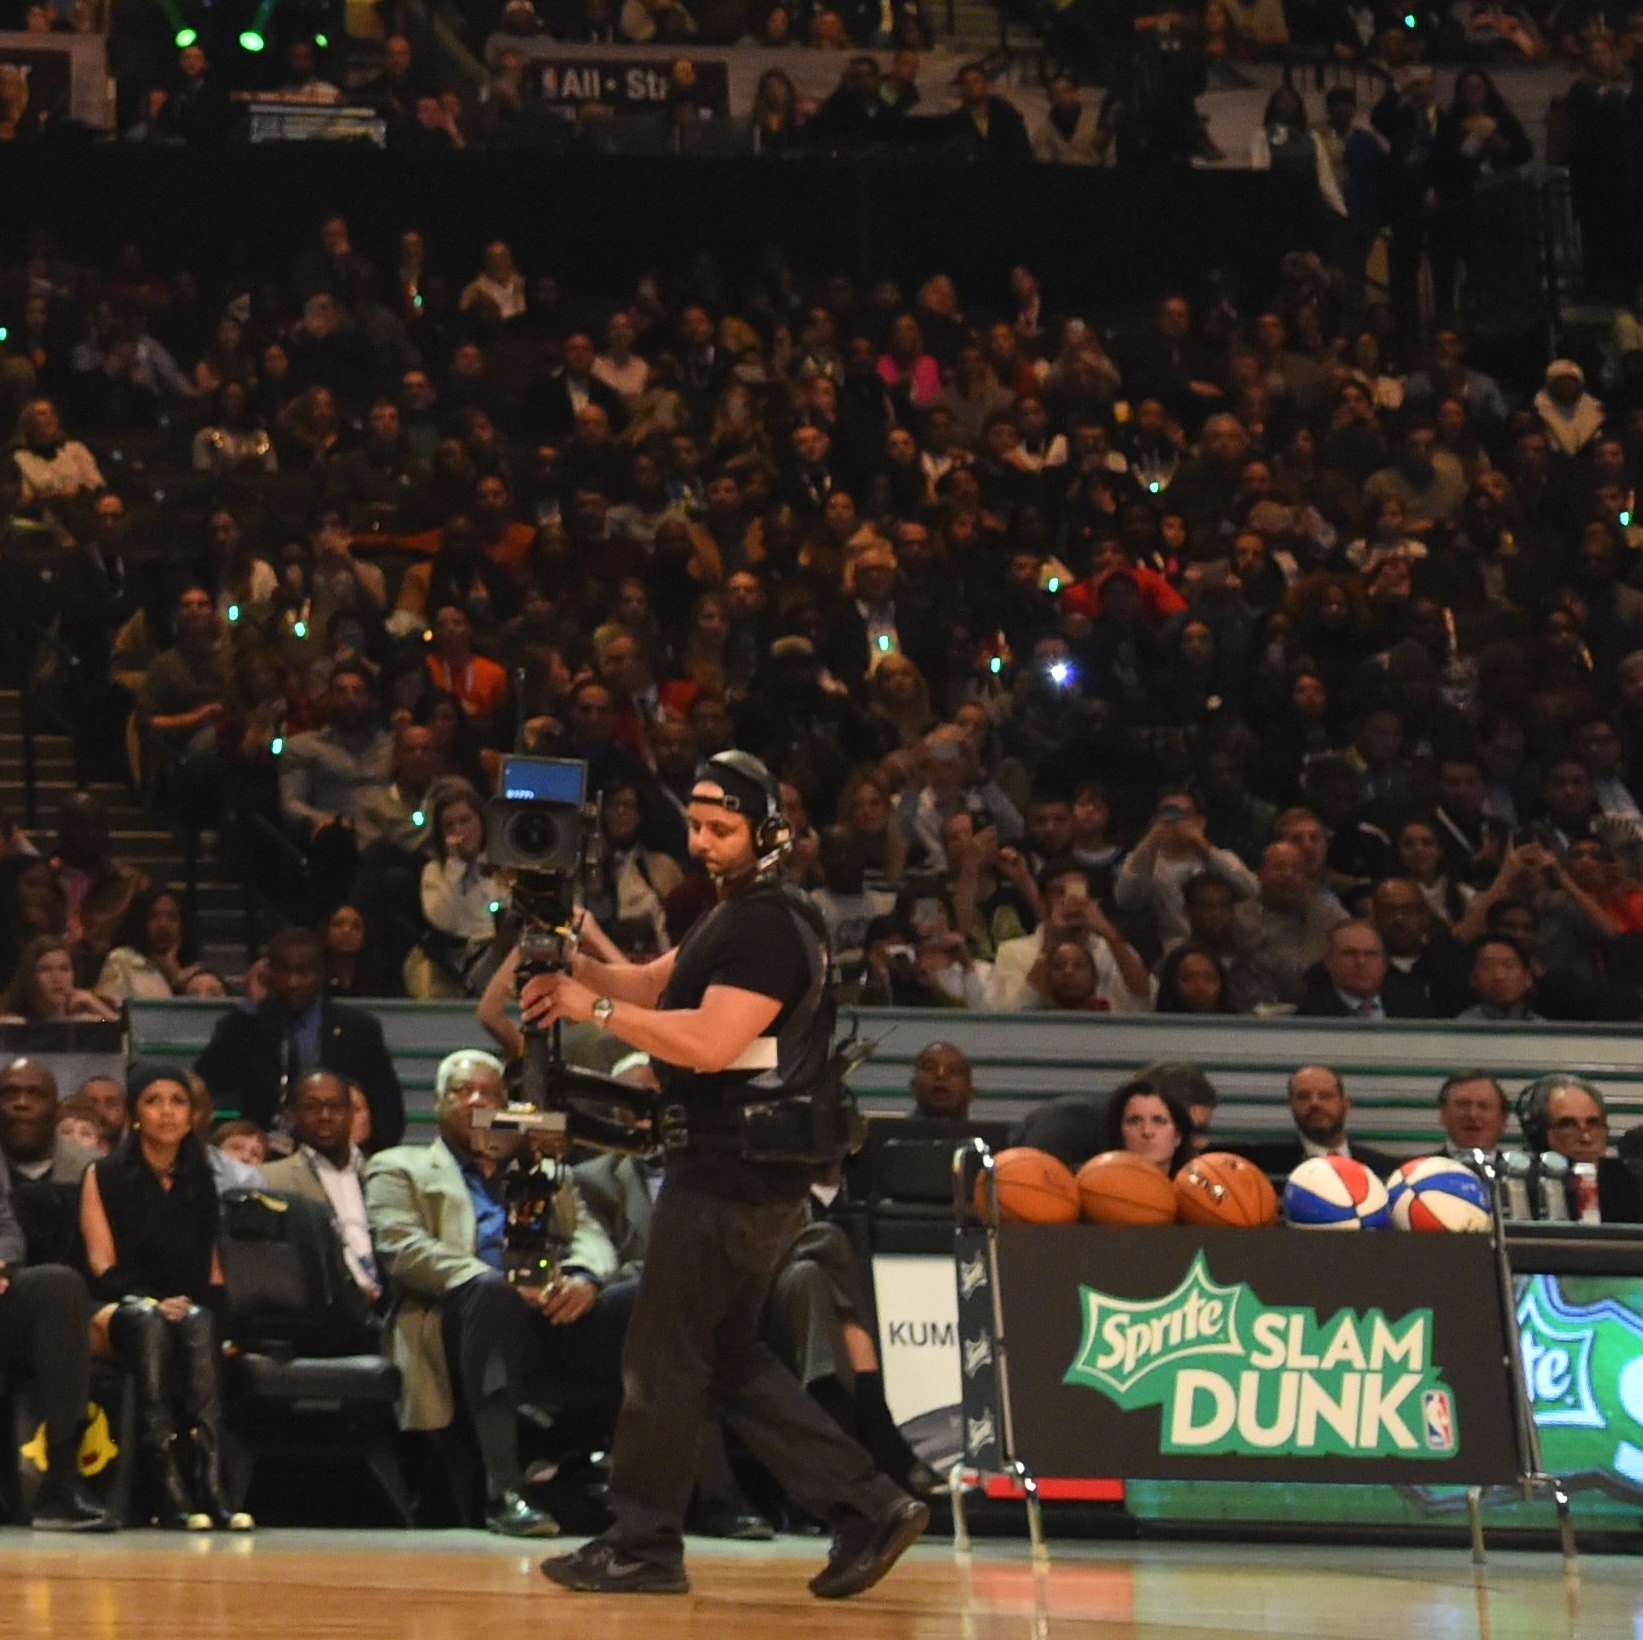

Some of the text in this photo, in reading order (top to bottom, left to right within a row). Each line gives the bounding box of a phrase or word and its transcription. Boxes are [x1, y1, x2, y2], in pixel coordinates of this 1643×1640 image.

[1096, 1287, 1425, 1374] Sprite SLAM
[1171, 1368, 1423, 1449] DUNK
